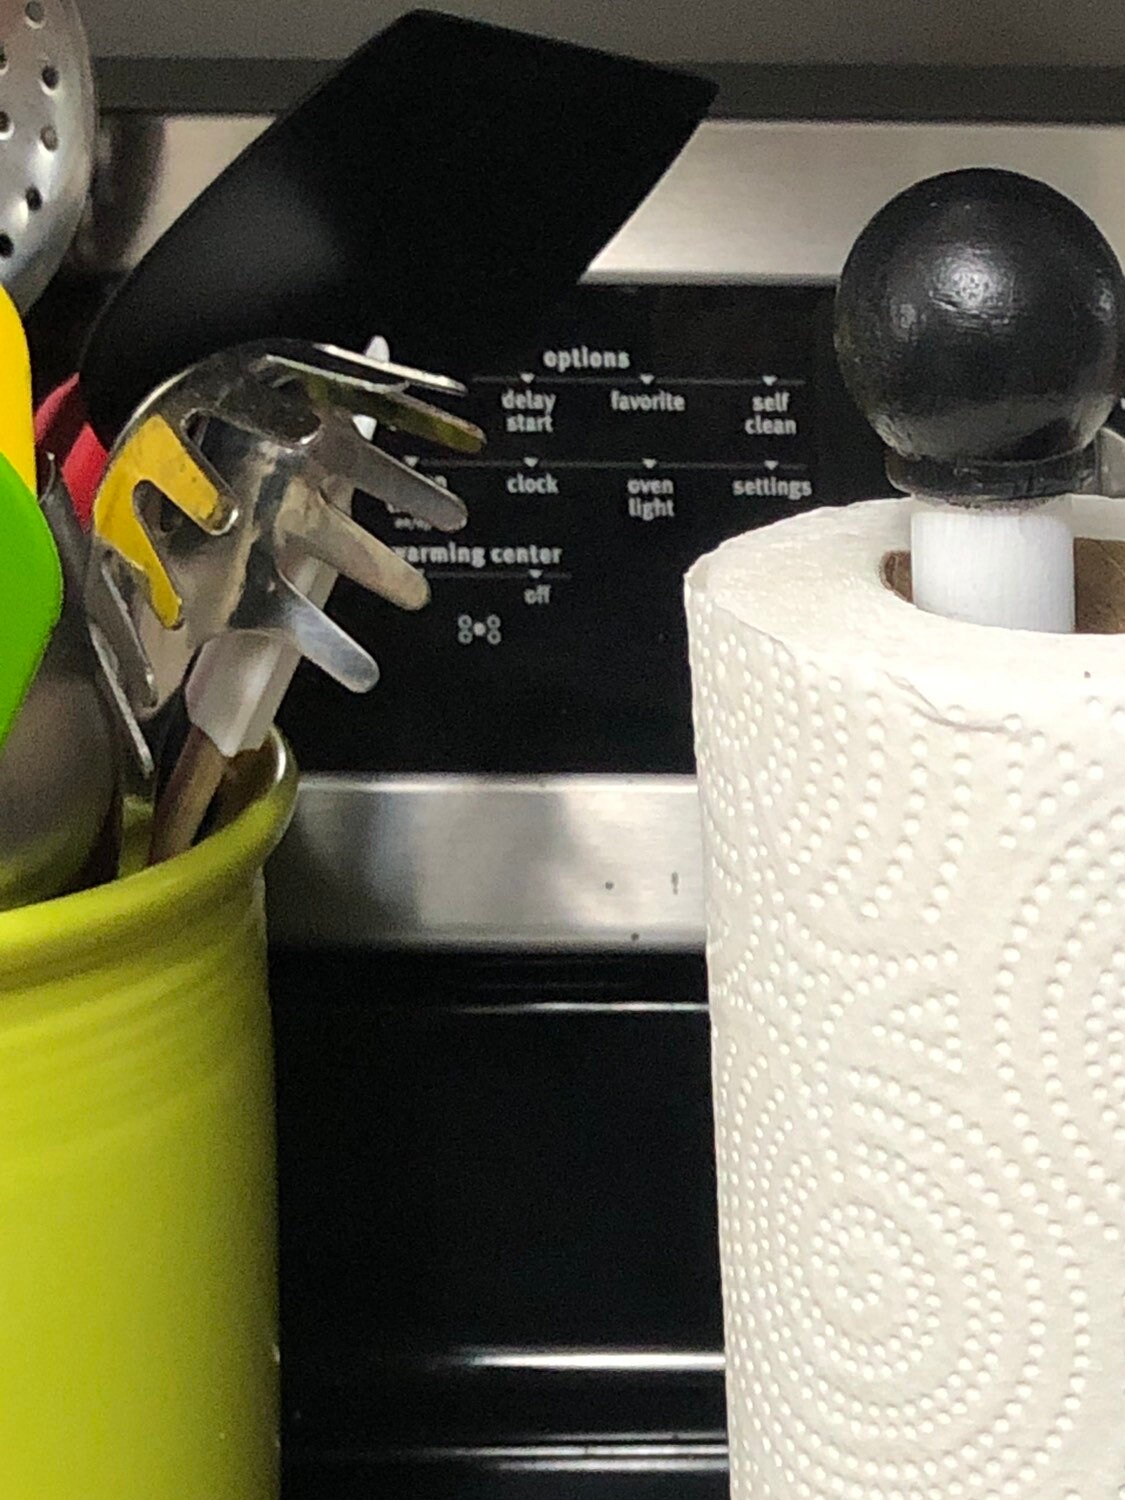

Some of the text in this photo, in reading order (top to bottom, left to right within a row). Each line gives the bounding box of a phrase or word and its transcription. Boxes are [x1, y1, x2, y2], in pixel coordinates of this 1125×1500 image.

[543, 346, 630, 372] options
[501, 389, 556, 415] delay
[610, 389, 686, 412] favorite
[752, 392, 790, 413] self
[506, 413, 554, 433] start
[744, 414, 798, 435] clean
[506, 472, 559, 494] clock
[627, 478, 674, 495] oven
[732, 476, 812, 501] settings
[628, 497, 675, 522] light
[489, 544, 564, 565] center
[523, 584, 551, 605] off
